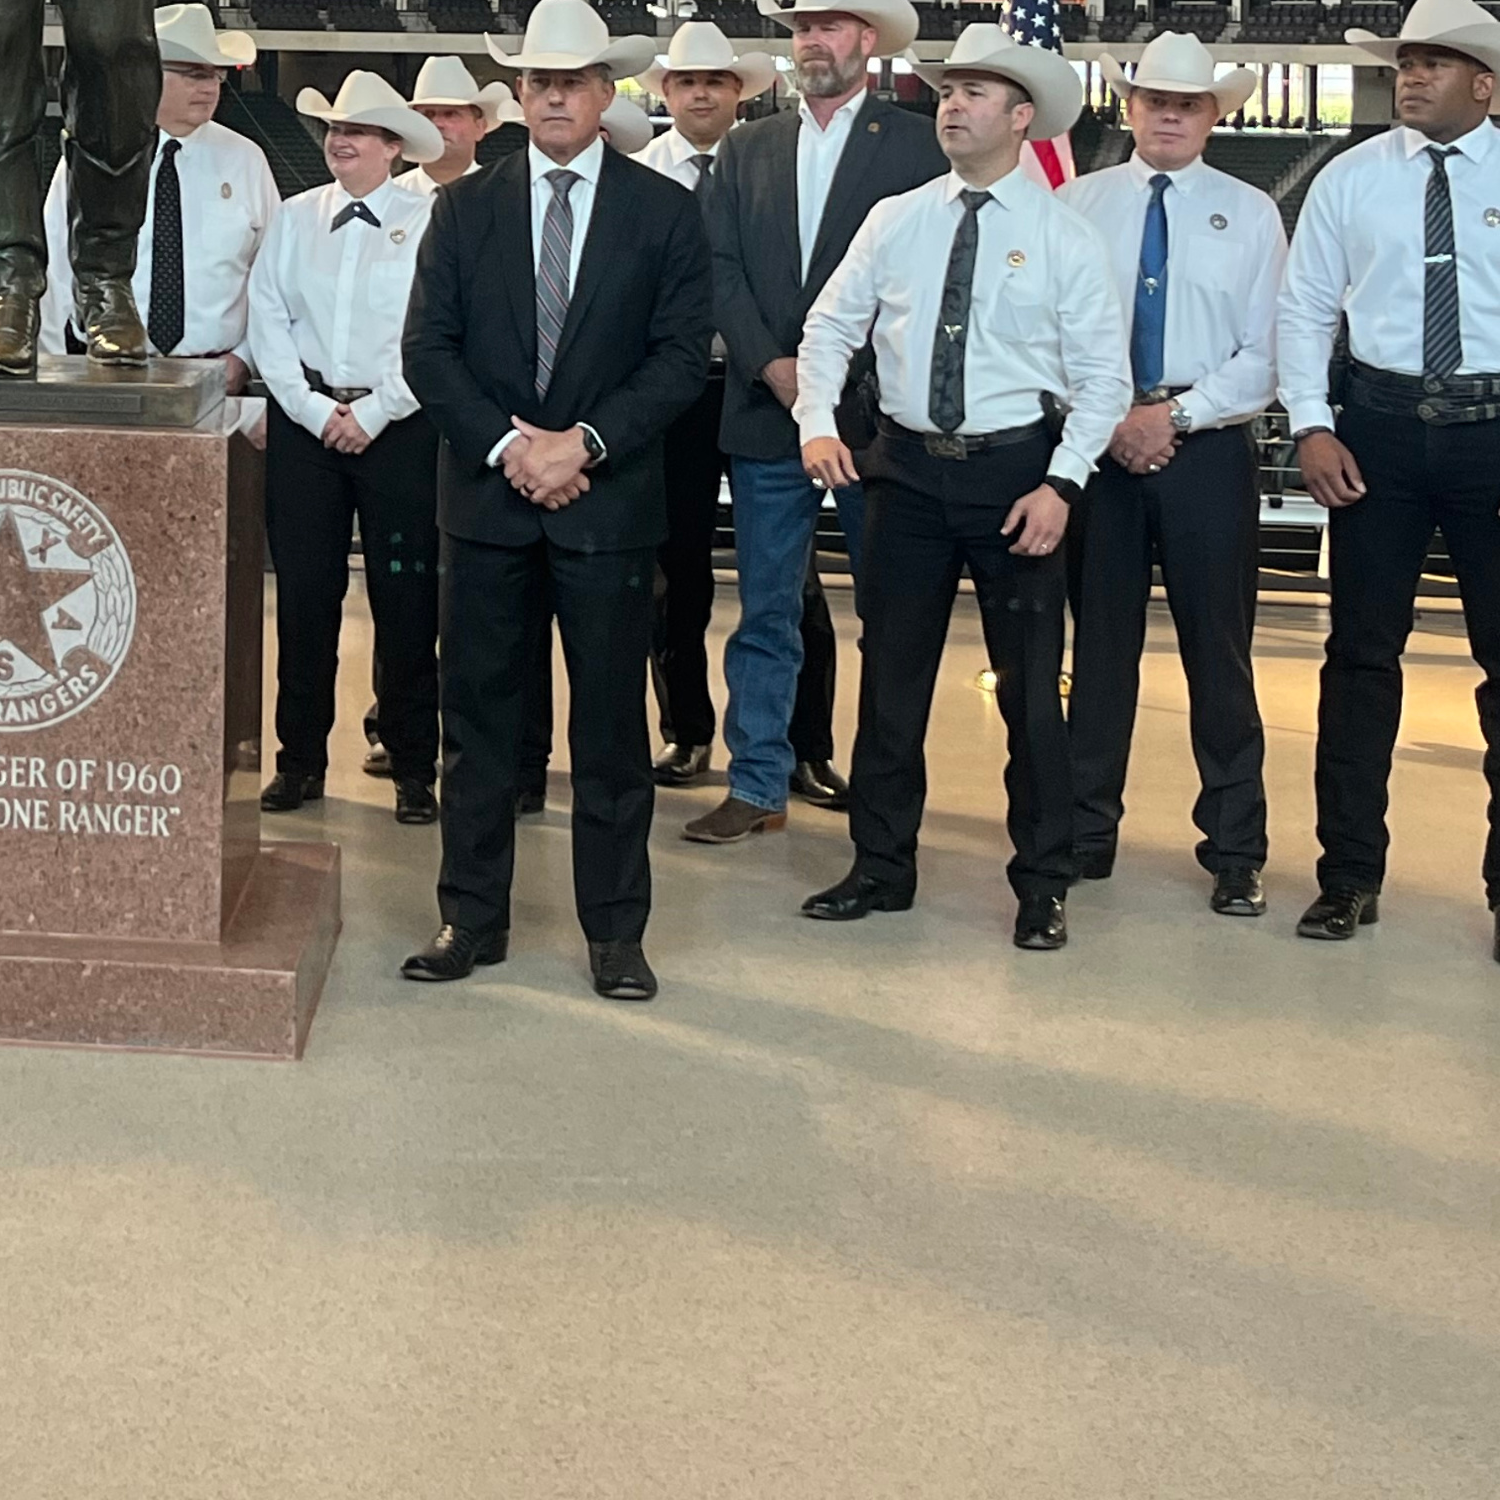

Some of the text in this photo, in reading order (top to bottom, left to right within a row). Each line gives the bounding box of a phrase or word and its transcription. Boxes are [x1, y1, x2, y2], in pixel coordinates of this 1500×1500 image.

[48, 491, 107, 545] SAFETY
[56, 758, 97, 790] OF
[106, 761, 182, 794] 1960
